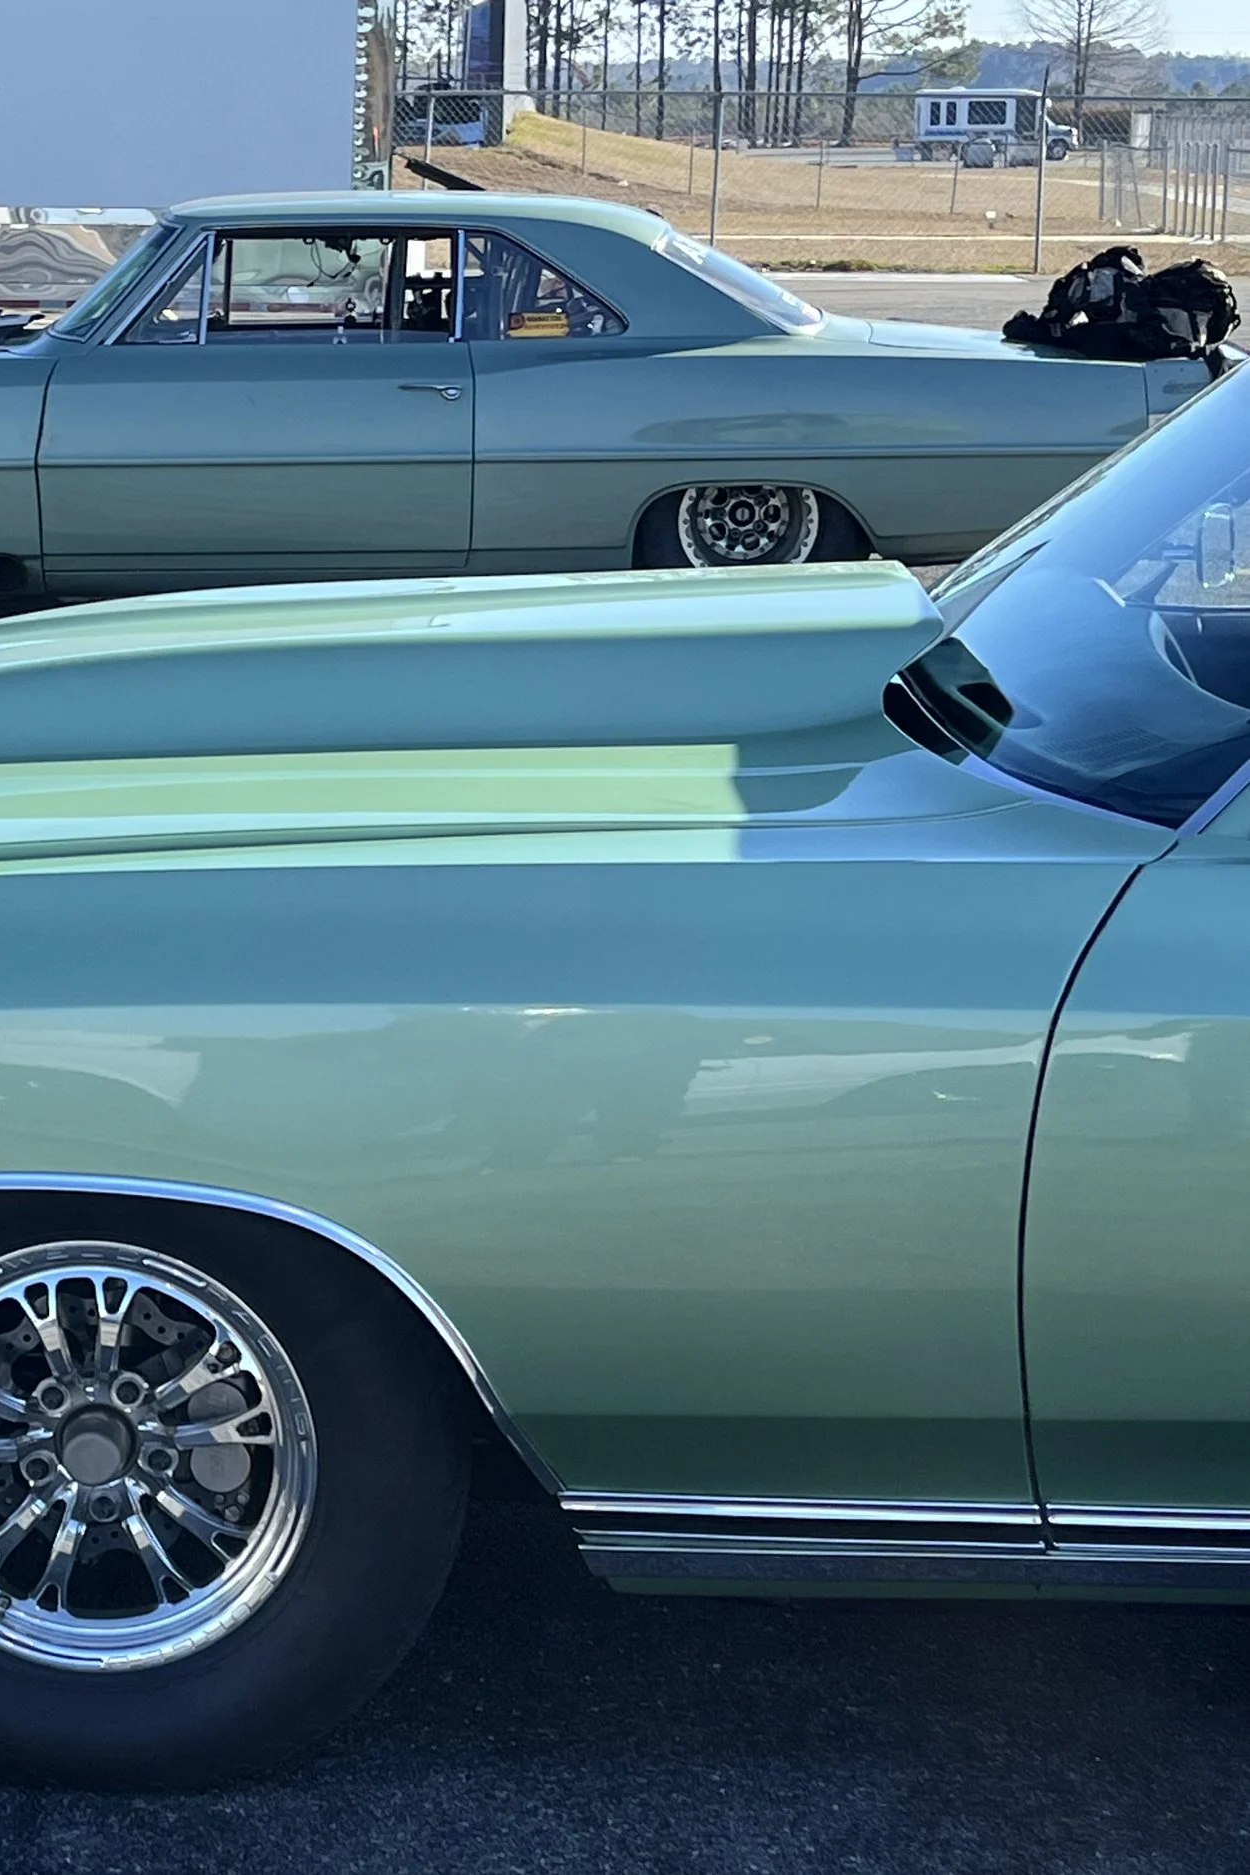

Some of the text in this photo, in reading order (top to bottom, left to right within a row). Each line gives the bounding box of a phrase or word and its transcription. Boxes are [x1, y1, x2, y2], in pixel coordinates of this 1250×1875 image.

[2, 1246, 314, 1438] WELD RACING
[105, 1572, 276, 1671] FORGED
